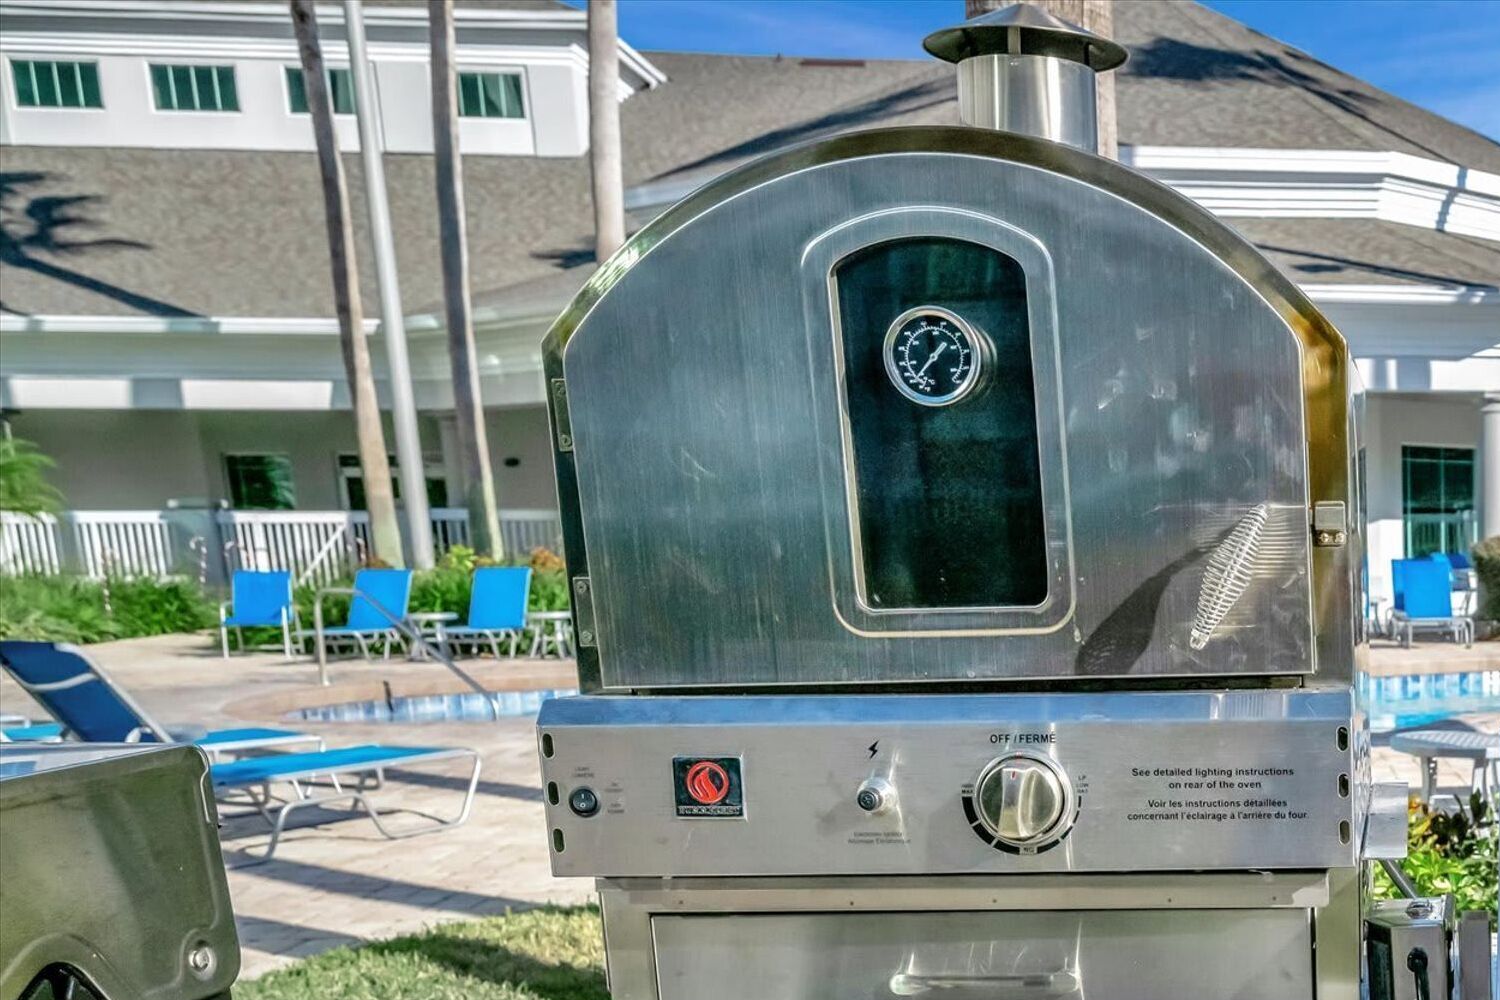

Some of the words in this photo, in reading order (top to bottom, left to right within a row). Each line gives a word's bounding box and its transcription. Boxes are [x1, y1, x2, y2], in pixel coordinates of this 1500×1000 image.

[990, 734, 1011, 744] OFF
[1132, 768, 1150, 776] See
[1153, 768, 1192, 776] detailed
[1195, 768, 1233, 778] lighting
[1235, 768, 1294, 776] instructions
[1206, 780, 1217, 789] of
[1219, 780, 1234, 789] the
[1237, 781, 1261, 789] oven
[1148, 800, 1166, 808] Voir
[1169, 800, 1182, 808] les
[1185, 799, 1241, 808] instructions
[1127, 812, 1178, 820] concernant
[1275, 811, 1286, 819] du
